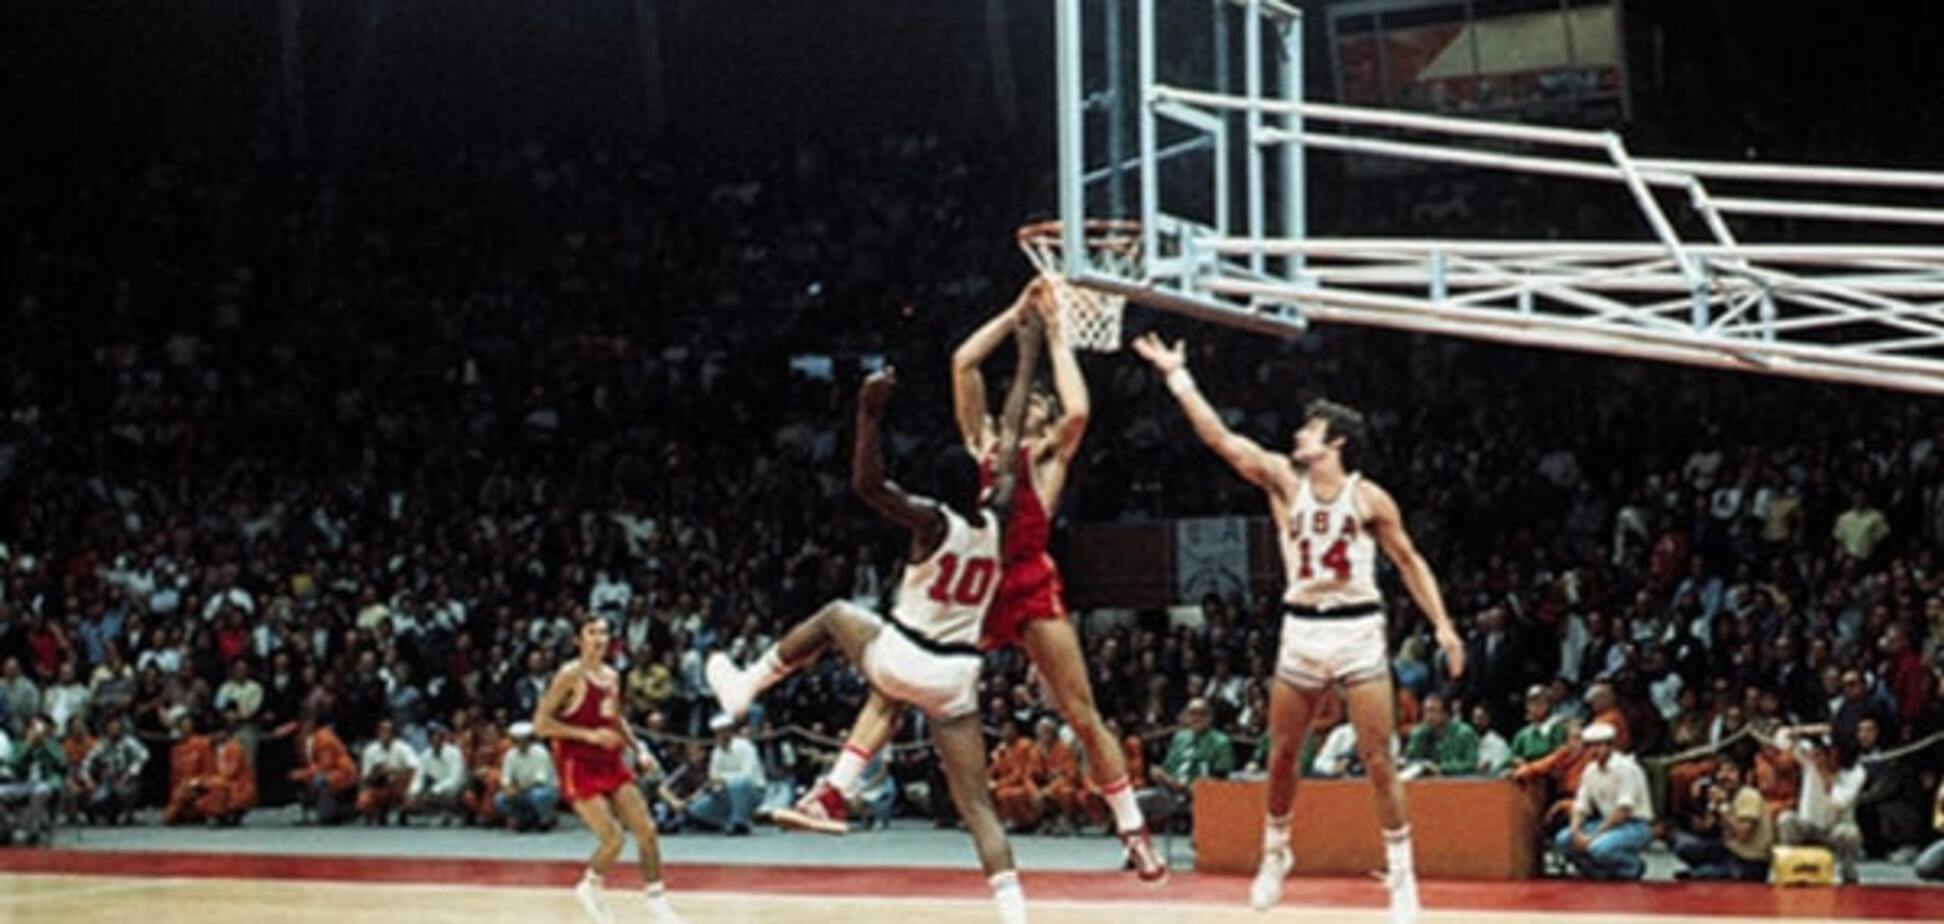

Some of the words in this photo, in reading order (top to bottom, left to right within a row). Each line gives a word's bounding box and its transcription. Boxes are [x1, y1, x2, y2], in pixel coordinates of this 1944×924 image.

[1289, 510, 1357, 541] USA
[929, 552, 994, 606] 10
[1298, 539, 1352, 581] 14
